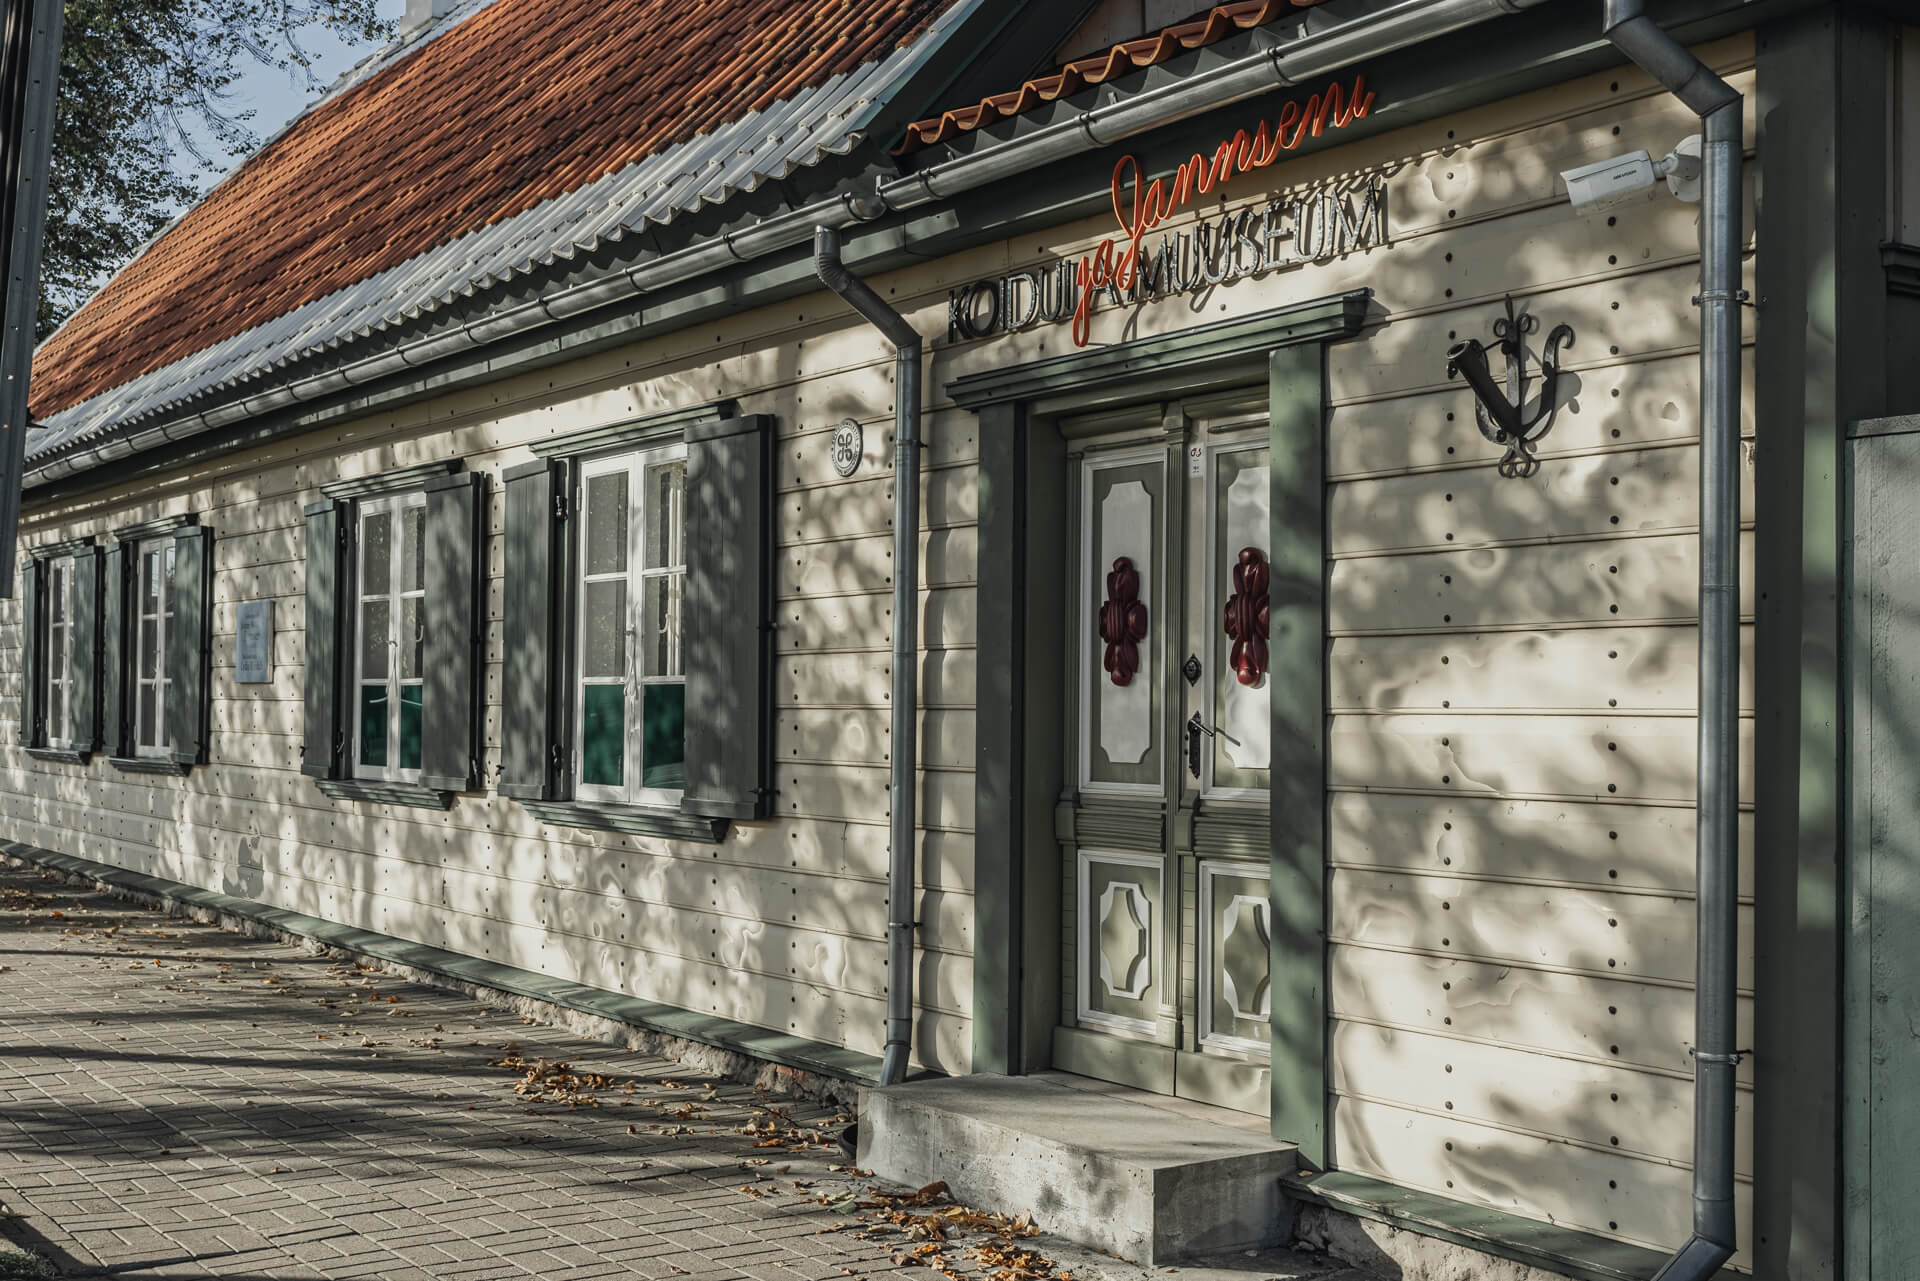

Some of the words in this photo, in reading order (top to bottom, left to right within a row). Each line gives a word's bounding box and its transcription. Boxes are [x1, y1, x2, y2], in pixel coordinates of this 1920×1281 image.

[1073, 239, 1124, 347] ja
[1112, 75, 1376, 290] Jannseni
[1128, 180, 1379, 301] MUUSEUM
